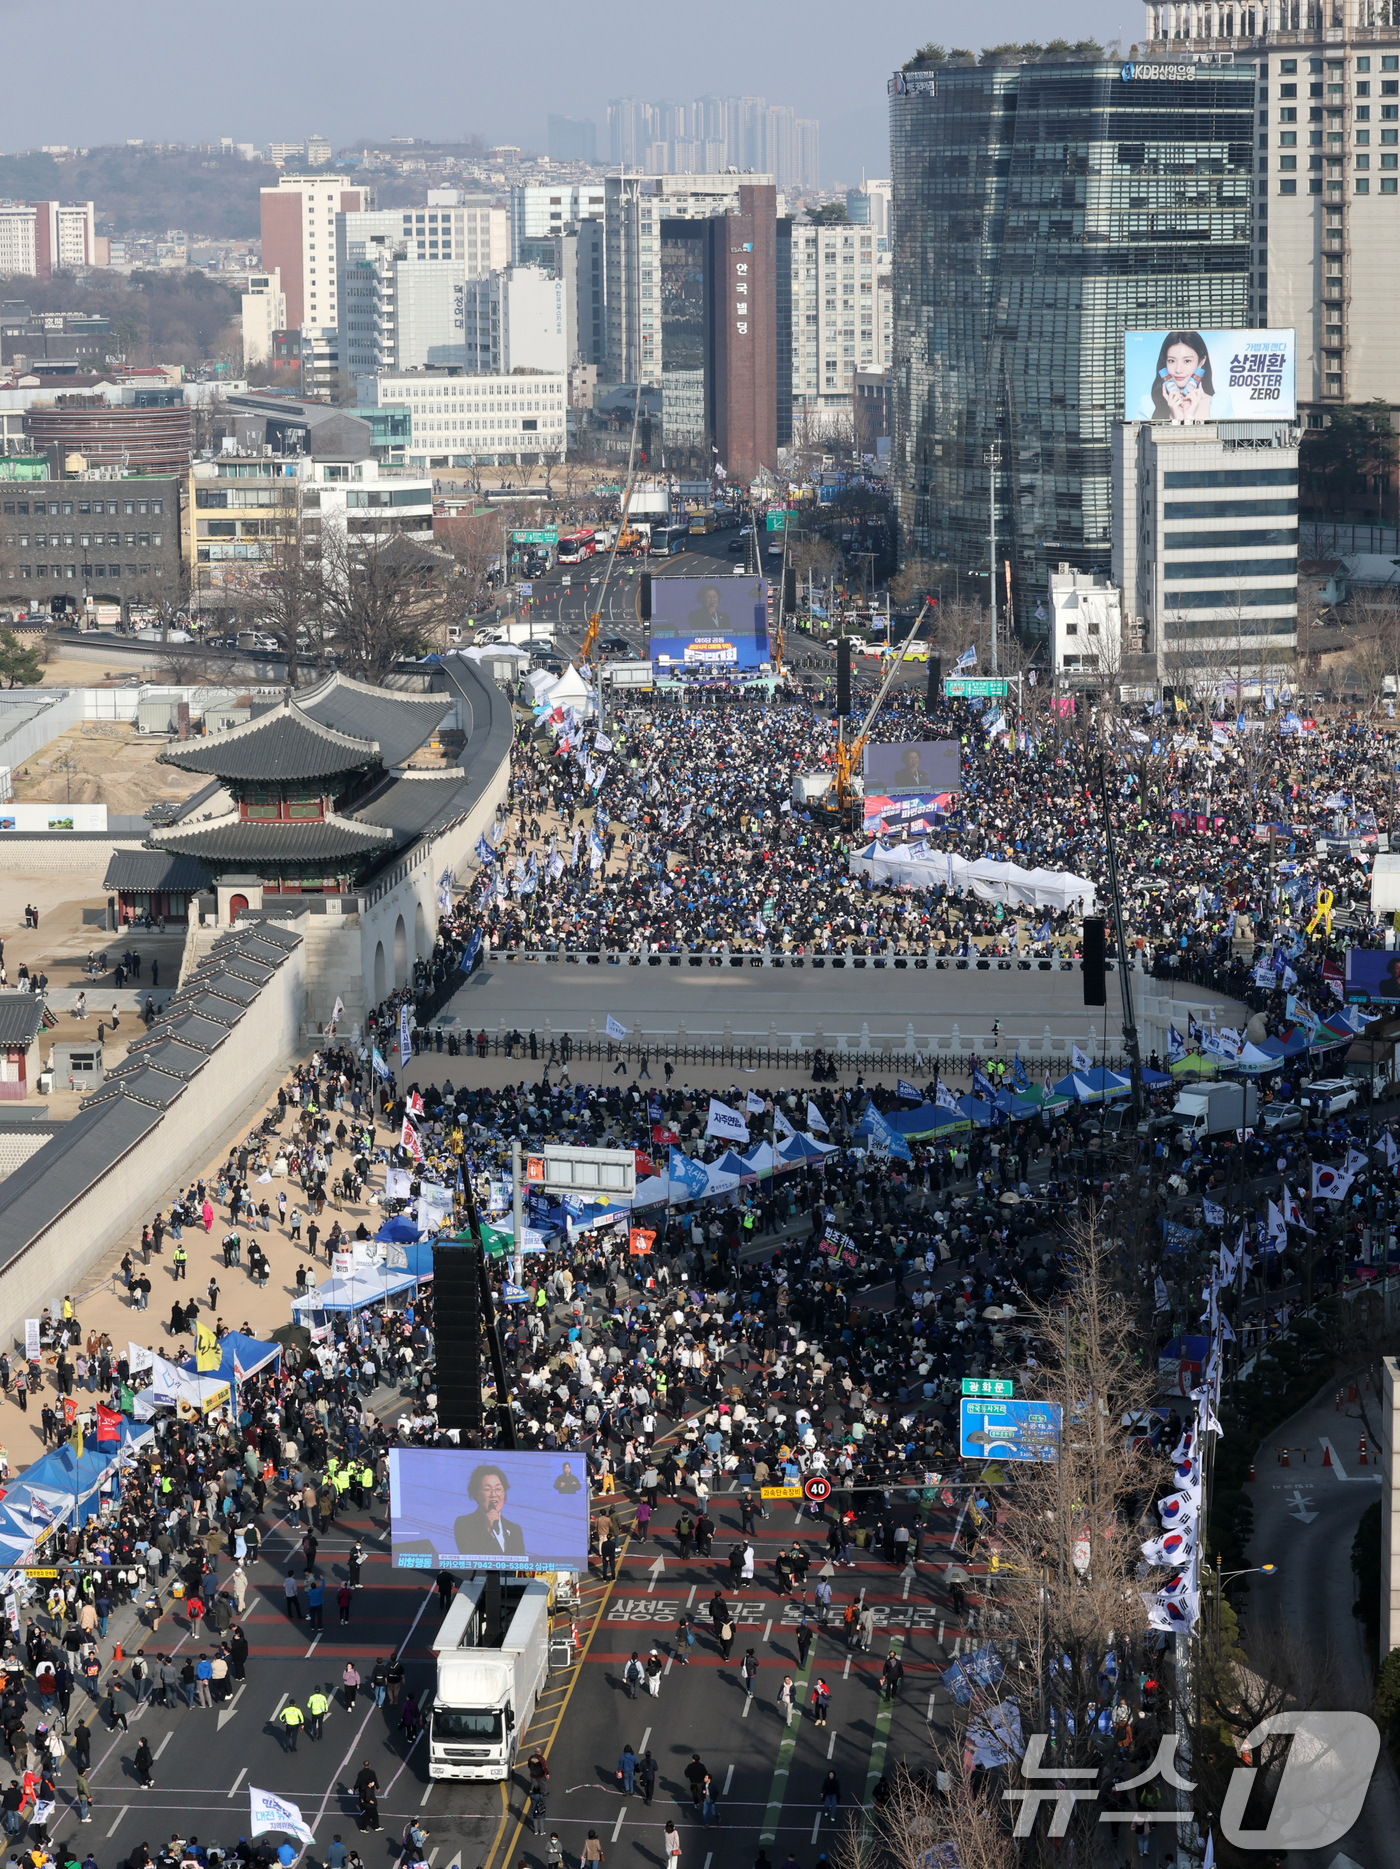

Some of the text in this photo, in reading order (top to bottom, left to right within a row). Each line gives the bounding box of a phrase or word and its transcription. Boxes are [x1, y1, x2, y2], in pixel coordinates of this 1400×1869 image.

[1134, 64, 1196, 81] KDB산업은행
[735, 263, 748, 335] 안국빌딩
[1228, 352, 1287, 374] 상쾌환
[1228, 374, 1283, 387] BOOSTER
[1249, 387, 1281, 401] ZERO
[713, 1112, 744, 1129] 자주연합
[968, 1381, 1005, 1393] 광화문
[763, 1488, 801, 1497] 과속단속장비
[810, 1483, 825, 1495] 40
[398, 1557, 432, 1568] 비상행동
[438, 1560, 472, 1570] 카카오뱅크
[473, 1561, 534, 1570] 7942-09-53862
[606, 1598, 681, 1622] 삼청동
[255, 1810, 275, 1821] 대전
